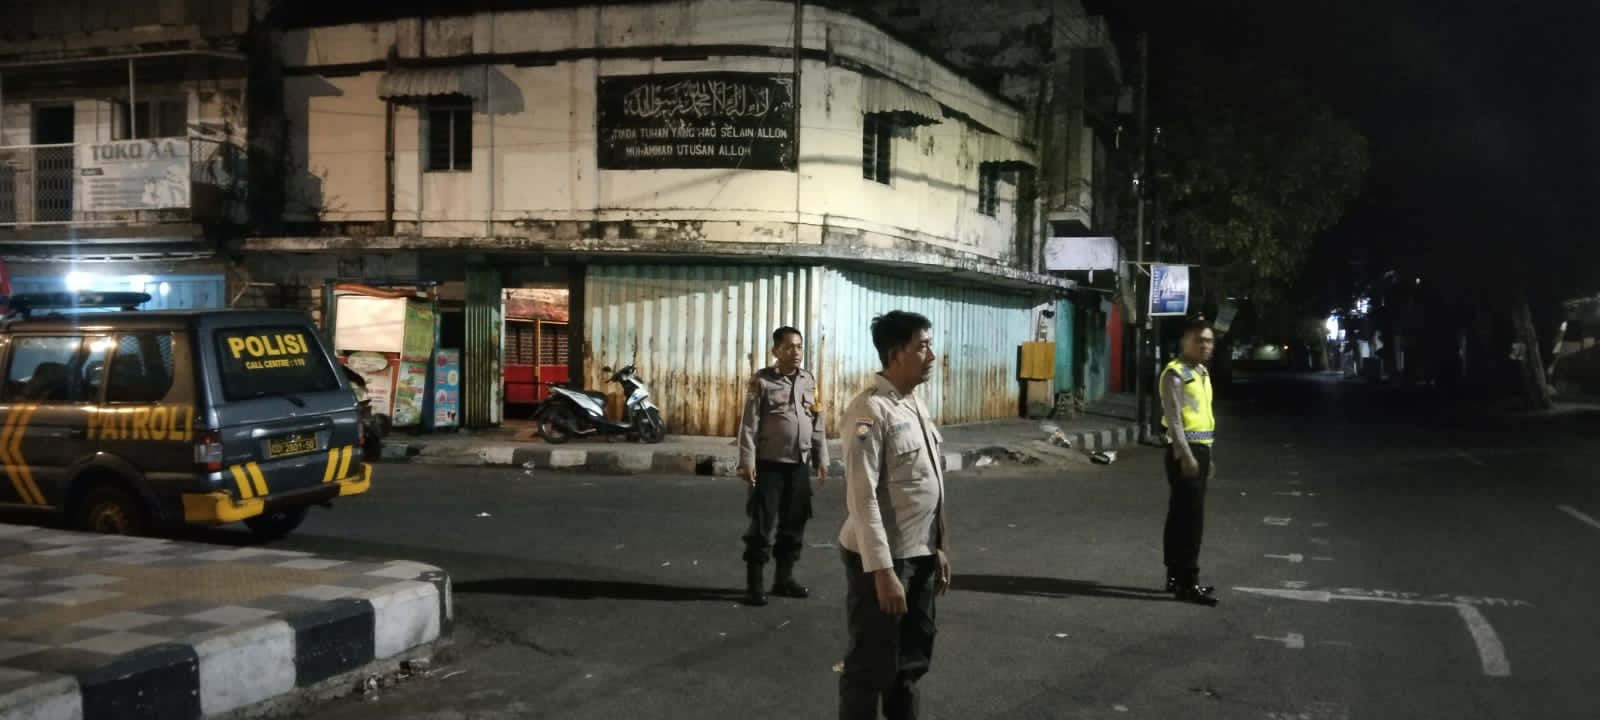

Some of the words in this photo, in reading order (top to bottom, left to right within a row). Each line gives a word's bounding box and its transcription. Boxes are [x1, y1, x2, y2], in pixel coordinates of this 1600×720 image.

[671, 128, 695, 138] YANG
[721, 127, 754, 138] SELAIN
[90, 143, 142, 161] TOKO
[677, 144, 714, 156] UTUSAN
[227, 333, 308, 358] POLISI
[245, 361, 264, 370] CALL
[264, 359, 289, 368] CENTRE
[87, 406, 193, 440] PATROLI
